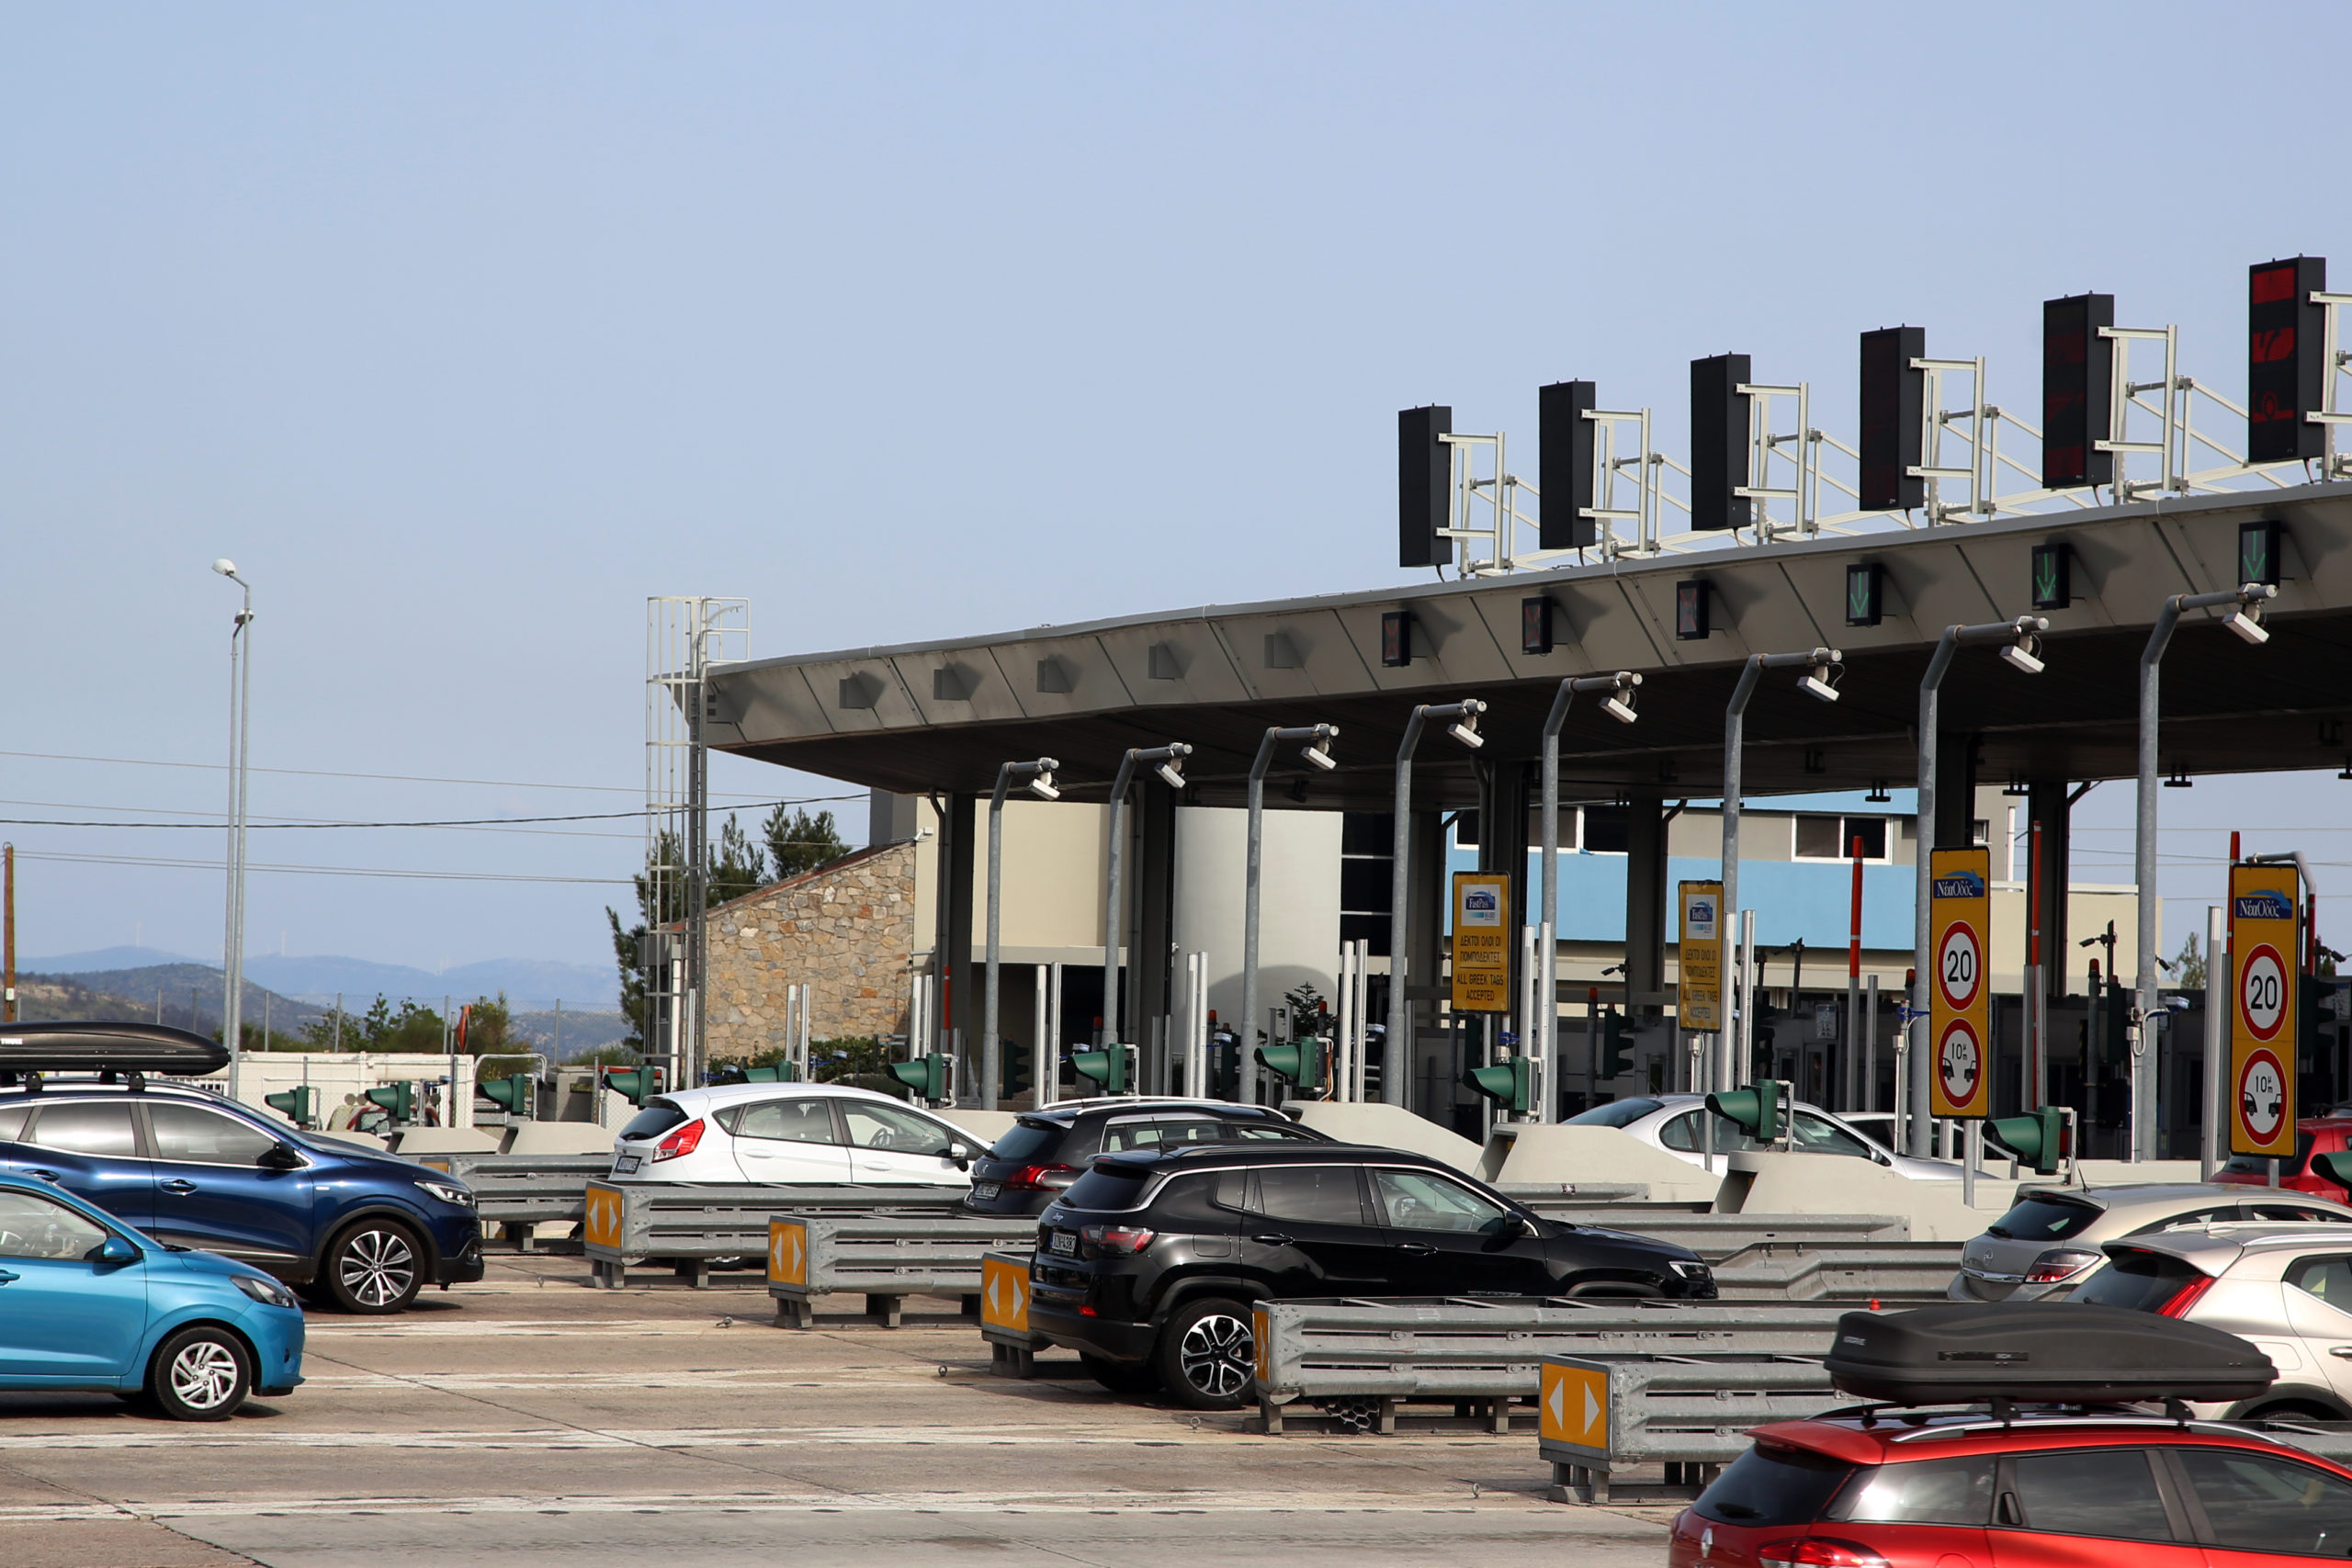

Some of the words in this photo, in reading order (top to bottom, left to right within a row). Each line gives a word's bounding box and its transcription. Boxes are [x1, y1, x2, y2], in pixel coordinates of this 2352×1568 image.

[1947, 949, 1972, 982] 20
[1456, 973, 1467, 985] ALL
[1469, 974, 1487, 985] GREEK
[1490, 974, 1504, 986] TAGS
[1466, 989, 1495, 1001] ACCEPTED
[2250, 975, 2278, 1010] 20
[1951, 1043, 1962, 1059] 10
[2256, 1076, 2267, 1092] 10
